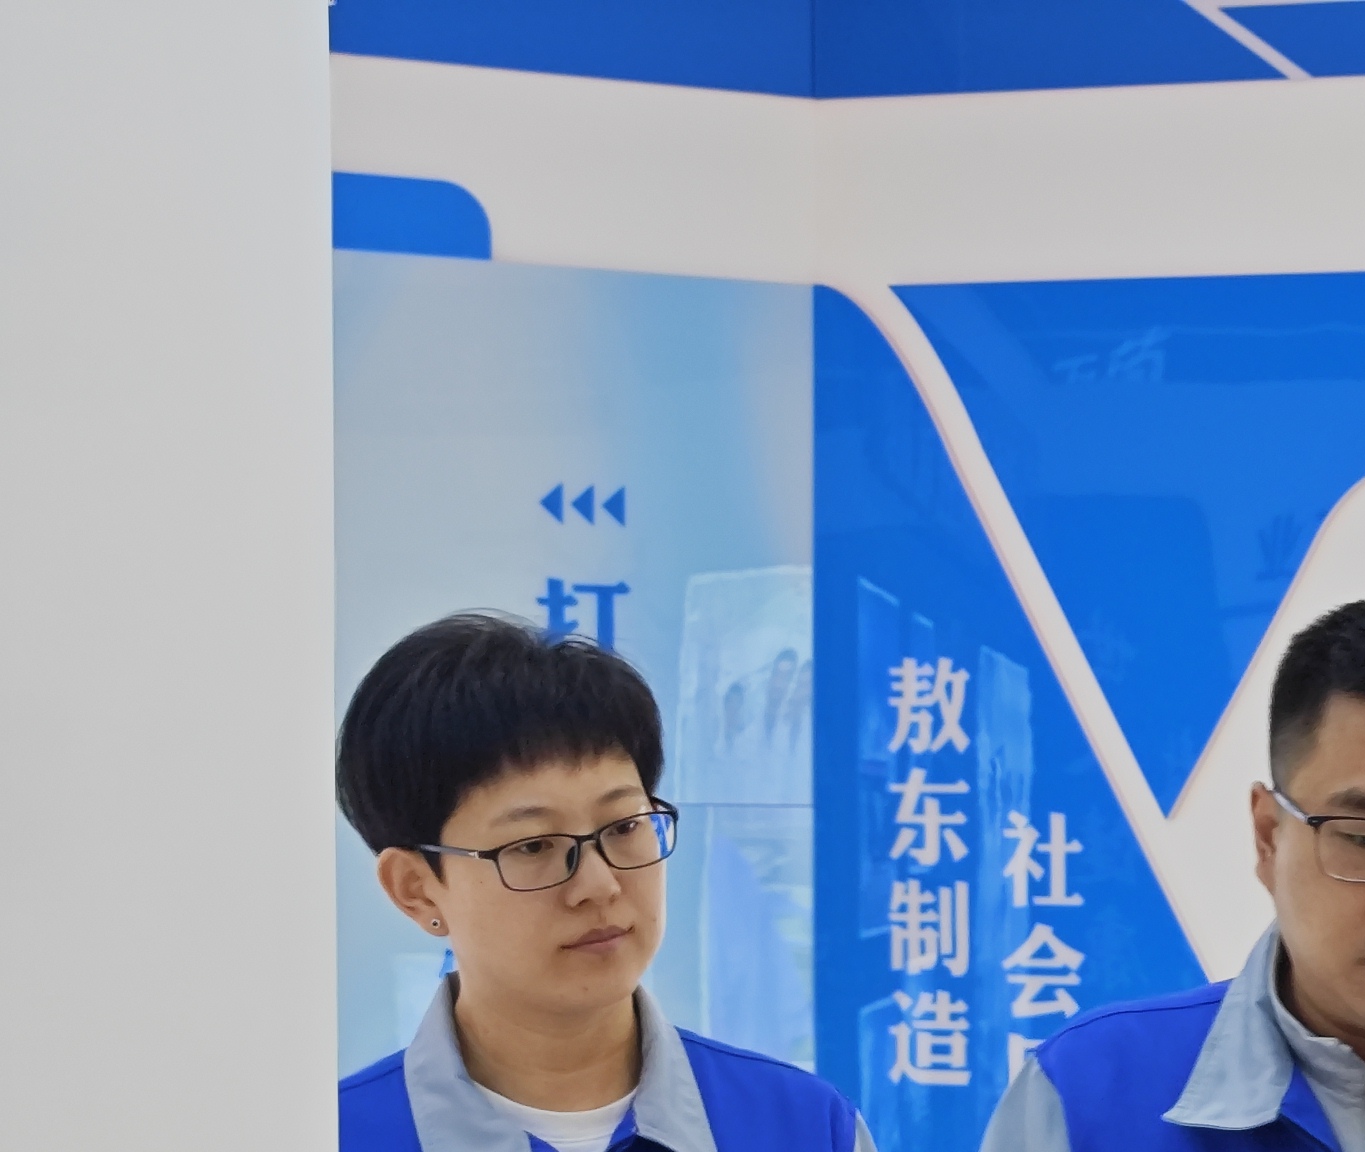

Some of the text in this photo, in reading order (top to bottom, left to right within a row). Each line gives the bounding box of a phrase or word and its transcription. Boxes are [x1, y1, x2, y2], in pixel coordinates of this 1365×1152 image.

[535, 577, 631, 651] 打
[887, 656, 972, 1087] 敖东制造
[1001, 812, 1086, 1084] 社会
